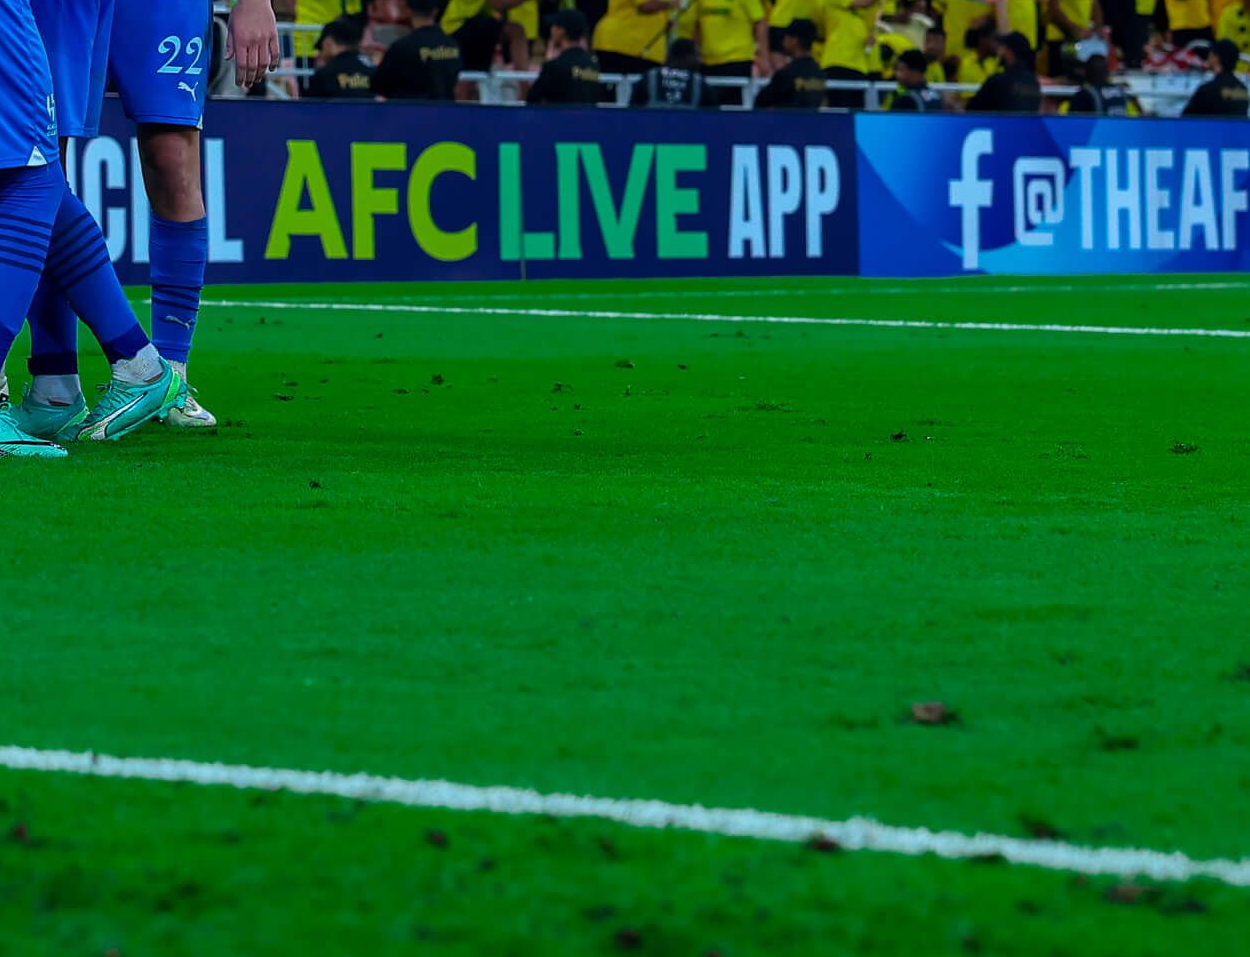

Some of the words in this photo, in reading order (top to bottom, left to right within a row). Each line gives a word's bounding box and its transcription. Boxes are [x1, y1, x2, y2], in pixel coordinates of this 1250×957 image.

[156, 35, 203, 75] 22
[264, 139, 477, 262] AFC
[499, 141, 709, 261] LIVE
[728, 144, 840, 259] APP
